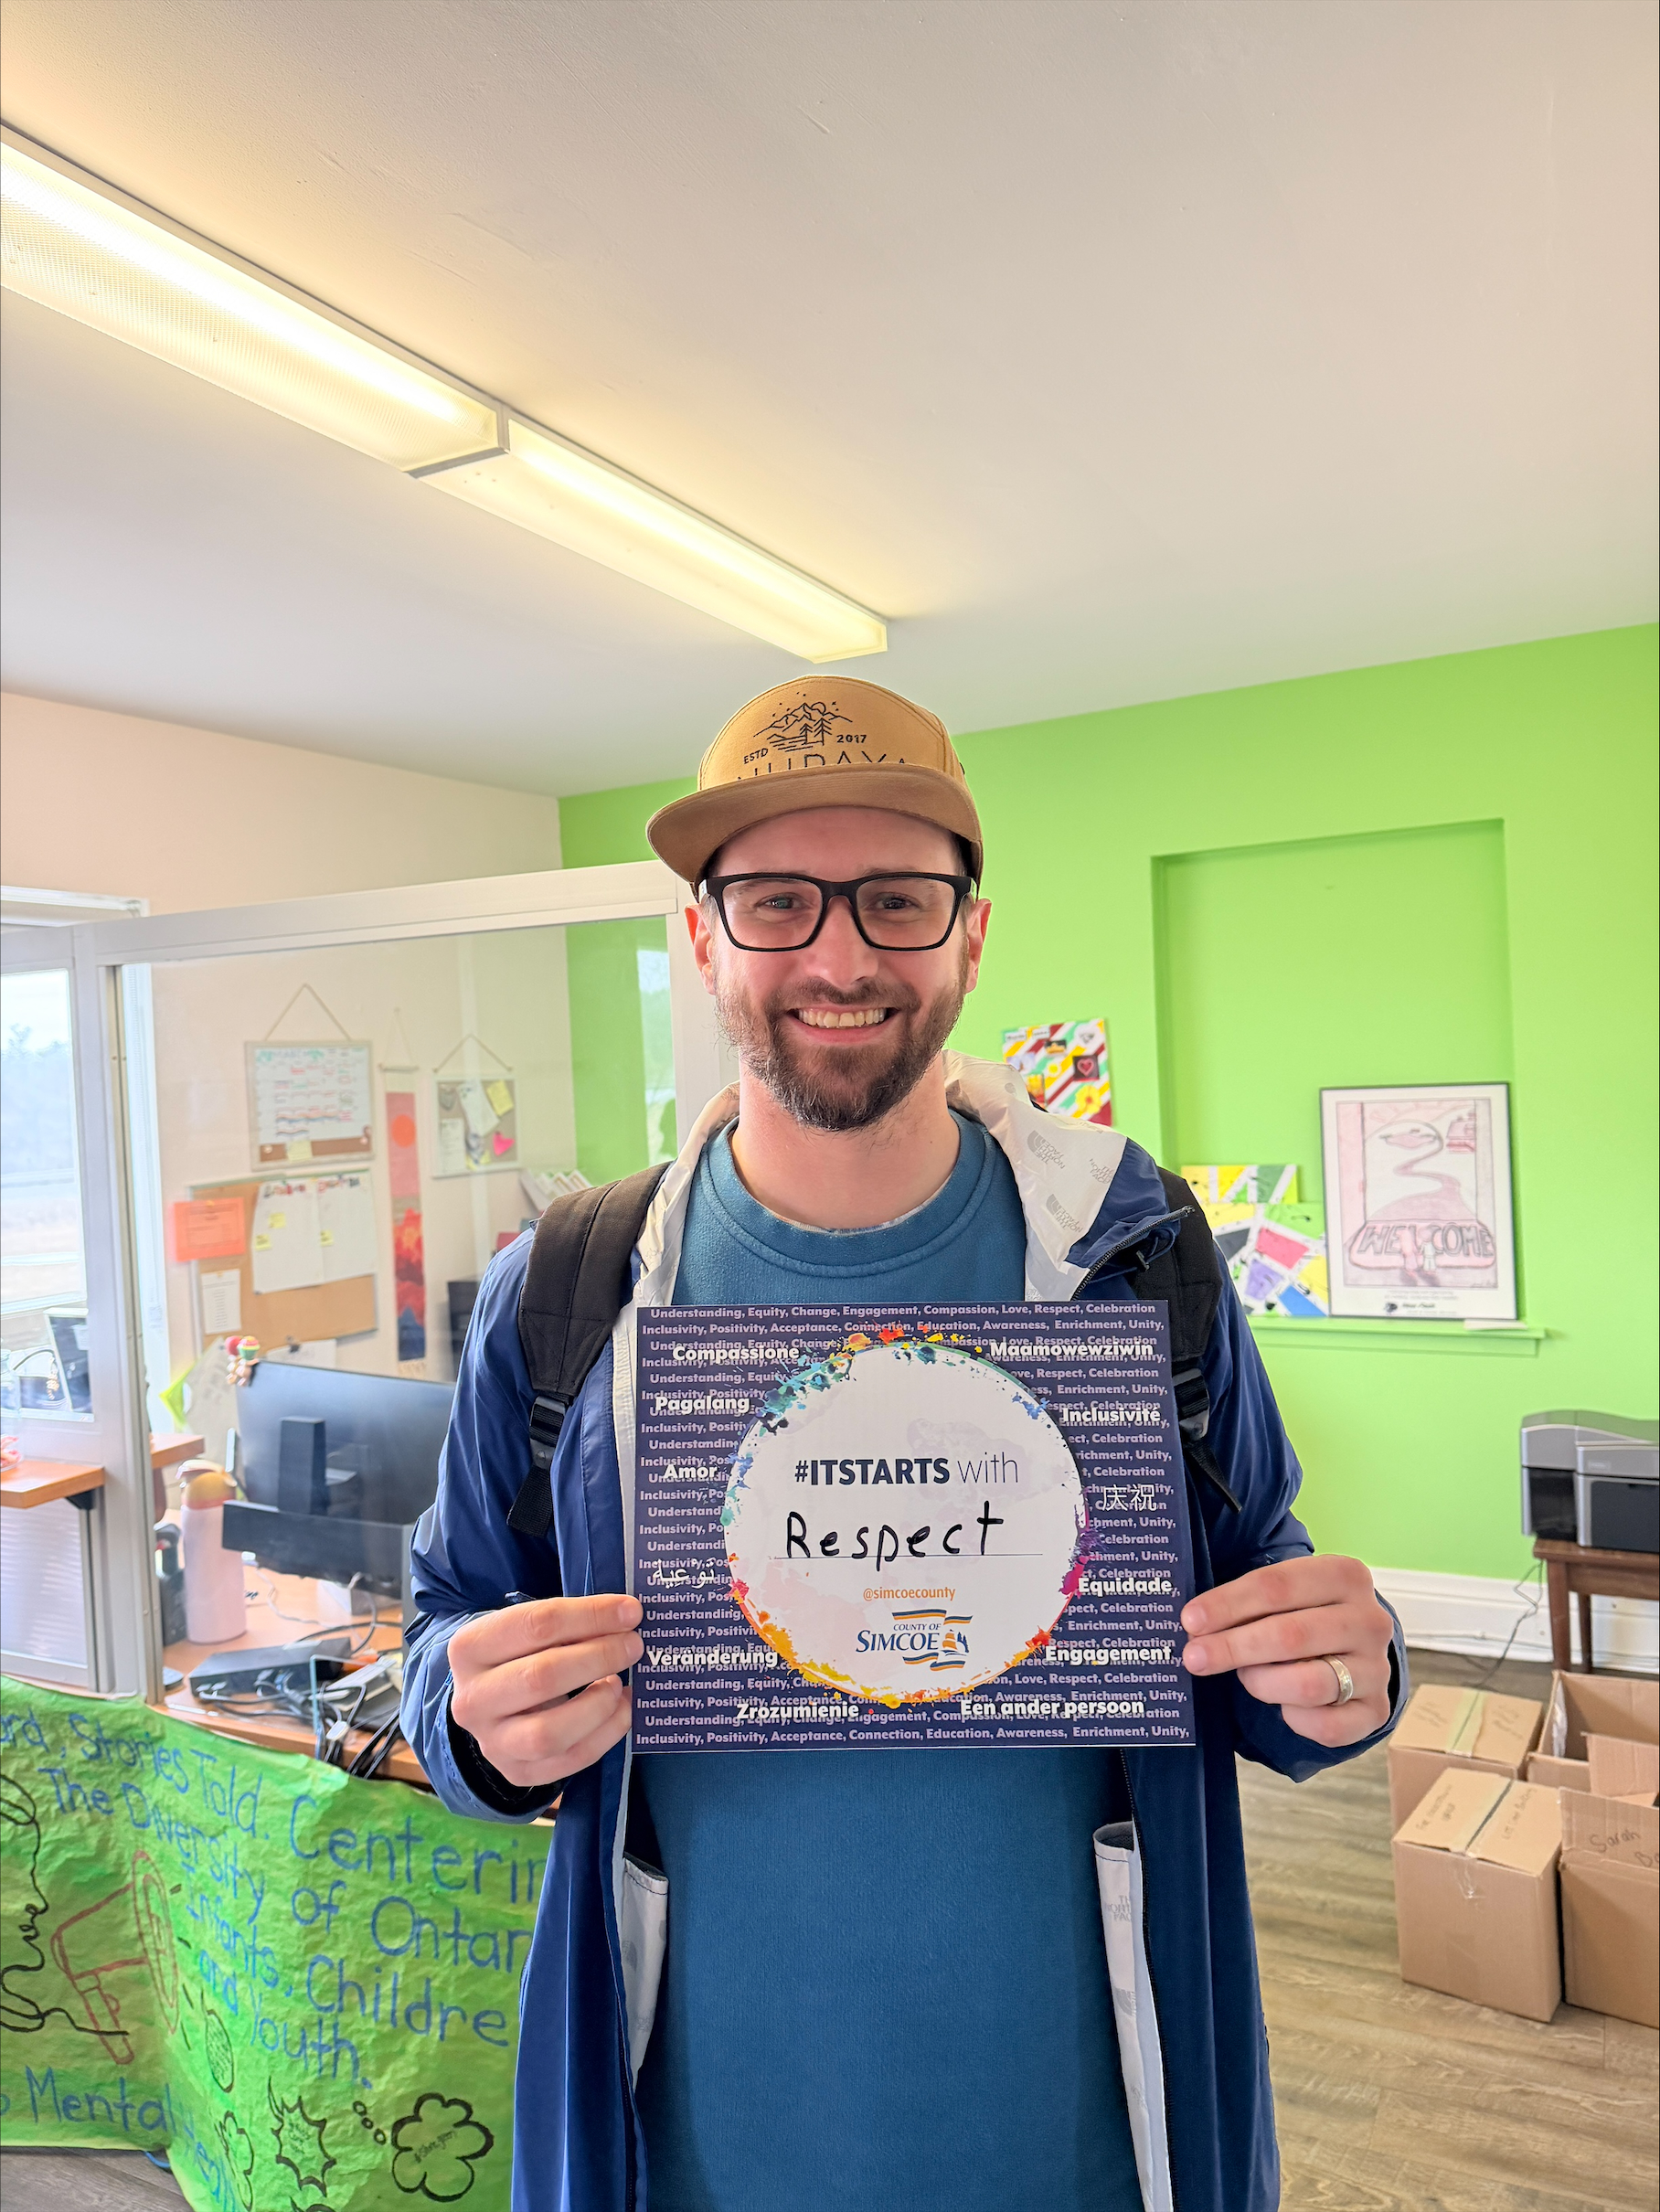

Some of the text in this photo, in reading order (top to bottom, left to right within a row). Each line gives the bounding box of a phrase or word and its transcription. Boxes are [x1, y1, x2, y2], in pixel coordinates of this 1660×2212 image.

[836, 734, 867, 744] 2017
[743, 748, 768, 764] ESTD
[650, 1303, 1155, 1320] Understanding, Equity, Change, Engagement, Compassion, Love, Respect, Celebration
[643, 1319, 1165, 1336] Inclusivity, Positivity, Acceptance, Connection, Education, Awareness, Enrichment, Unity,
[673, 1345, 799, 1364] Compassione
[990, 1342, 1154, 1356] Maamowewziwin
[650, 1372, 745, 1385] Understanding,
[1037, 1368, 1086, 1380] Respect,
[1088, 1367, 1159, 1377] Celebration
[1057, 1385, 1130, 1395] Enrichment,
[1132, 1384, 1168, 1396] Unity,
[655, 1395, 750, 1415] Pagalang
[1062, 1407, 1161, 1422] Inclusivité
[641, 1423, 707, 1434] Inclusivity,
[649, 1439, 736, 1450] Understandin
[1091, 1433, 1163, 1443] Celebration
[641, 1455, 707, 1467] Inclusivity,
[1073, 1450, 1172, 1462] richment, Unity,
[664, 1464, 718, 1479] Amor
[794, 1452, 1018, 1485] #ITSTARTS with
[1093, 1466, 1165, 1477] Celebration
[640, 1489, 708, 1502] Inclusivity,
[1102, 1484, 1157, 1512] 庆祝
[647, 1505, 722, 1517] Understand
[640, 1523, 707, 1536] Inclusivity,
[1139, 1516, 1176, 1530] Unity,
[787, 1500, 1004, 1571] Respect
[647, 1539, 726, 1552] Understandi
[1141, 1551, 1178, 1563] Unity,
[863, 1587, 956, 1601] @simcoecounty
[1078, 1577, 1173, 1597] Equidade
[1101, 1602, 1174, 1613] Celebration
[646, 1609, 745, 1622] Understanding,
[708, 1625, 758, 1637] Positivi
[893, 1622, 942, 1632] COUNTY OF
[1068, 1619, 1183, 1632] Enrichment, Unity,
[856, 1629, 941, 1653] SIMCOE
[1101, 1637, 1176, 1648] Celebration
[647, 1648, 779, 1668] Veränderung
[1045, 1645, 1172, 1665] Engagement
[645, 1679, 745, 1691] Understanding,
[747, 1677, 791, 1690] Equity,
[1015, 1674, 1047, 1685] Love,
[1049, 1673, 1101, 1686] Respect,
[1103, 1672, 1178, 1684] Celebration
[637, 1697, 705, 1709] Inclusivity,
[1149, 1689, 1187, 1703] Unity,
[736, 1701, 859, 1719] Zrozumienie
[961, 1698, 1144, 1719] Een ander persoon
[644, 1715, 745, 1727] Understanding,
[636, 1725, 1190, 1746] Inclusivity, Positivity, Acceptance, Connection, Education, Awareness, Enrichment, Unity,
[69, 1713, 189, 1793] Stories
[188, 1748, 270, 1840] Told.
[290, 1794, 548, 1903] Centerin
[38, 1767, 114, 1816] The
[292, 1879, 346, 1931] of
[371, 1895, 533, 1973] Ontar
[307, 1954, 509, 2047] Childre
[25, 2065, 176, 2134] Mental
